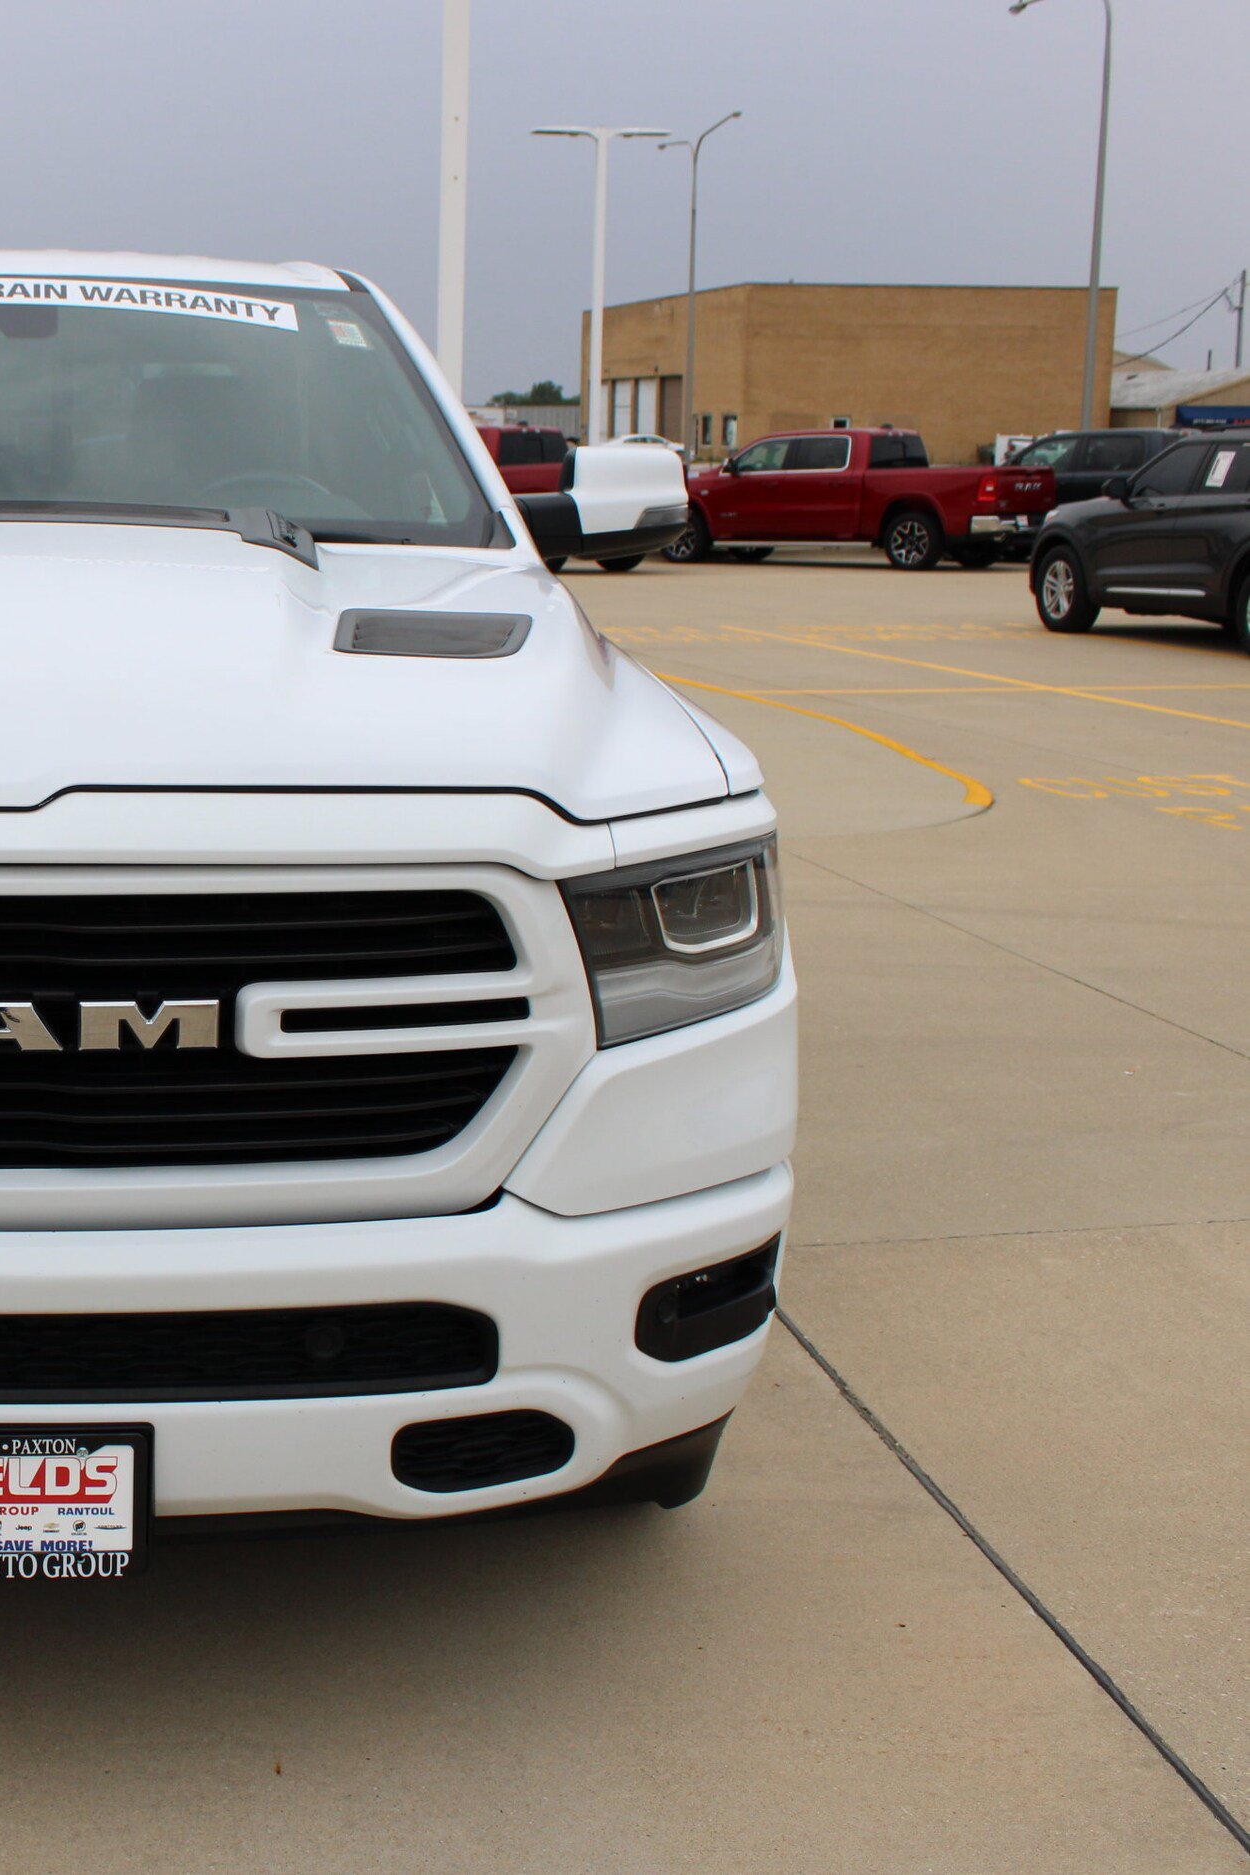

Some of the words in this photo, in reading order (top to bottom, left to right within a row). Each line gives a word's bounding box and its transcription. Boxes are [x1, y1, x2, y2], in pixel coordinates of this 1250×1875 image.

[79, 285, 282, 322] WARRANTY
[11, 1438, 77, 1455] PAXTON
[57, 1507, 116, 1516] RANTOUL
[40, 1540, 94, 1552] MORE!
[42, 1552, 131, 1578] GROUP
